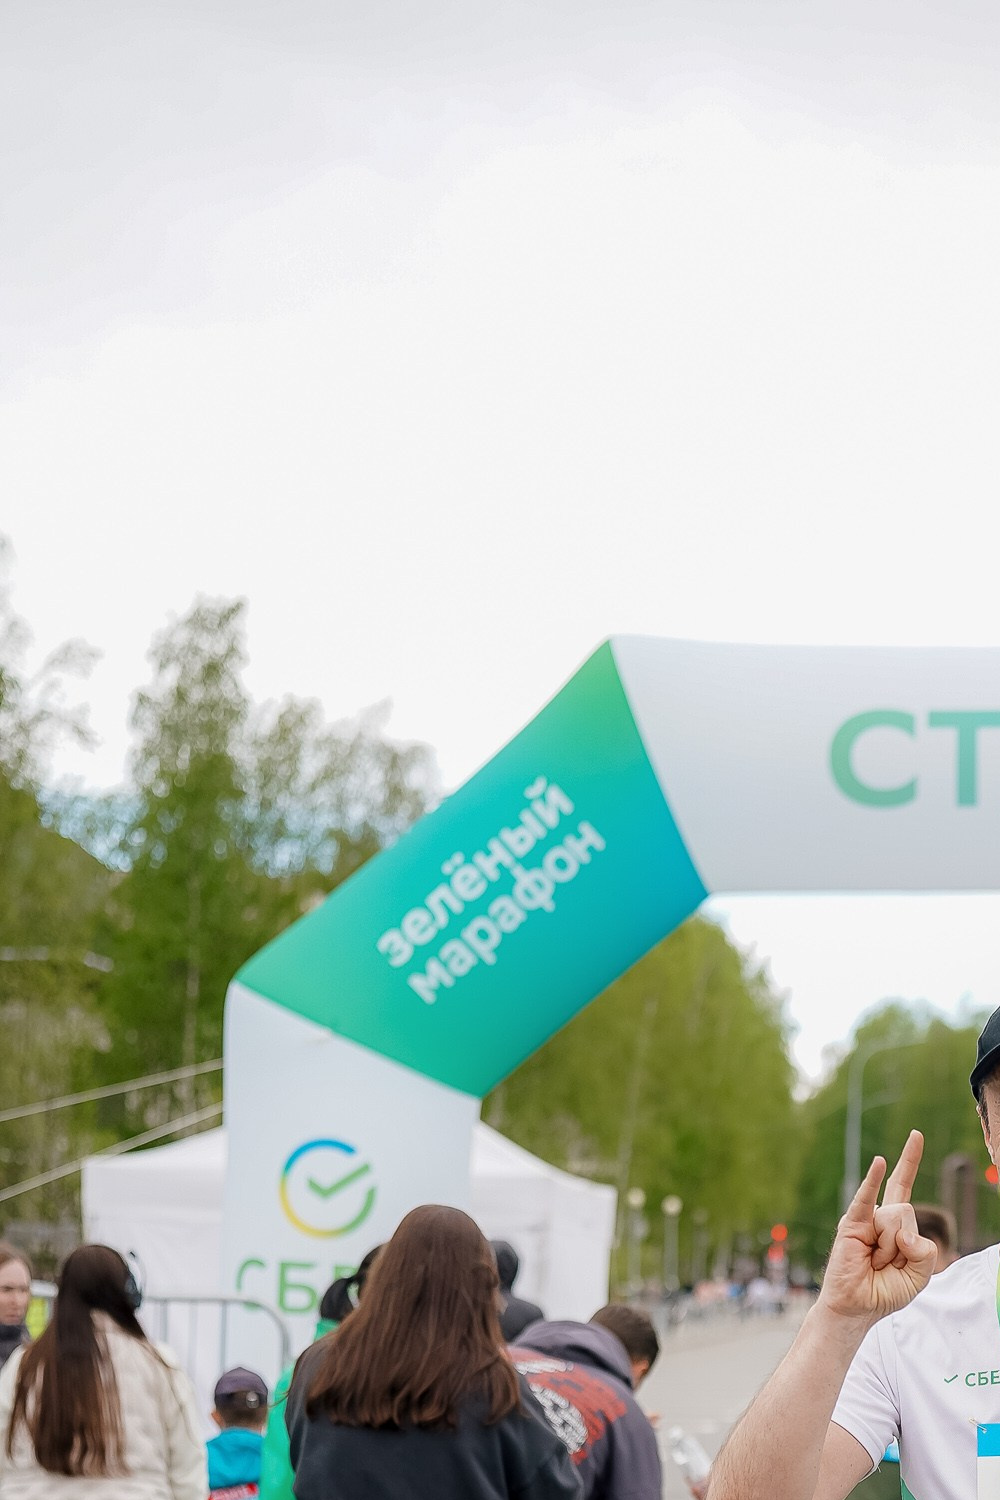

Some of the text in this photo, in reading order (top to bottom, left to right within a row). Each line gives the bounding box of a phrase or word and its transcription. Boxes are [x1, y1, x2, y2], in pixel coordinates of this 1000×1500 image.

[377, 776, 575, 968] зелёный
[407, 822, 606, 1004] марафон
[234, 1257, 359, 1313] СБ
